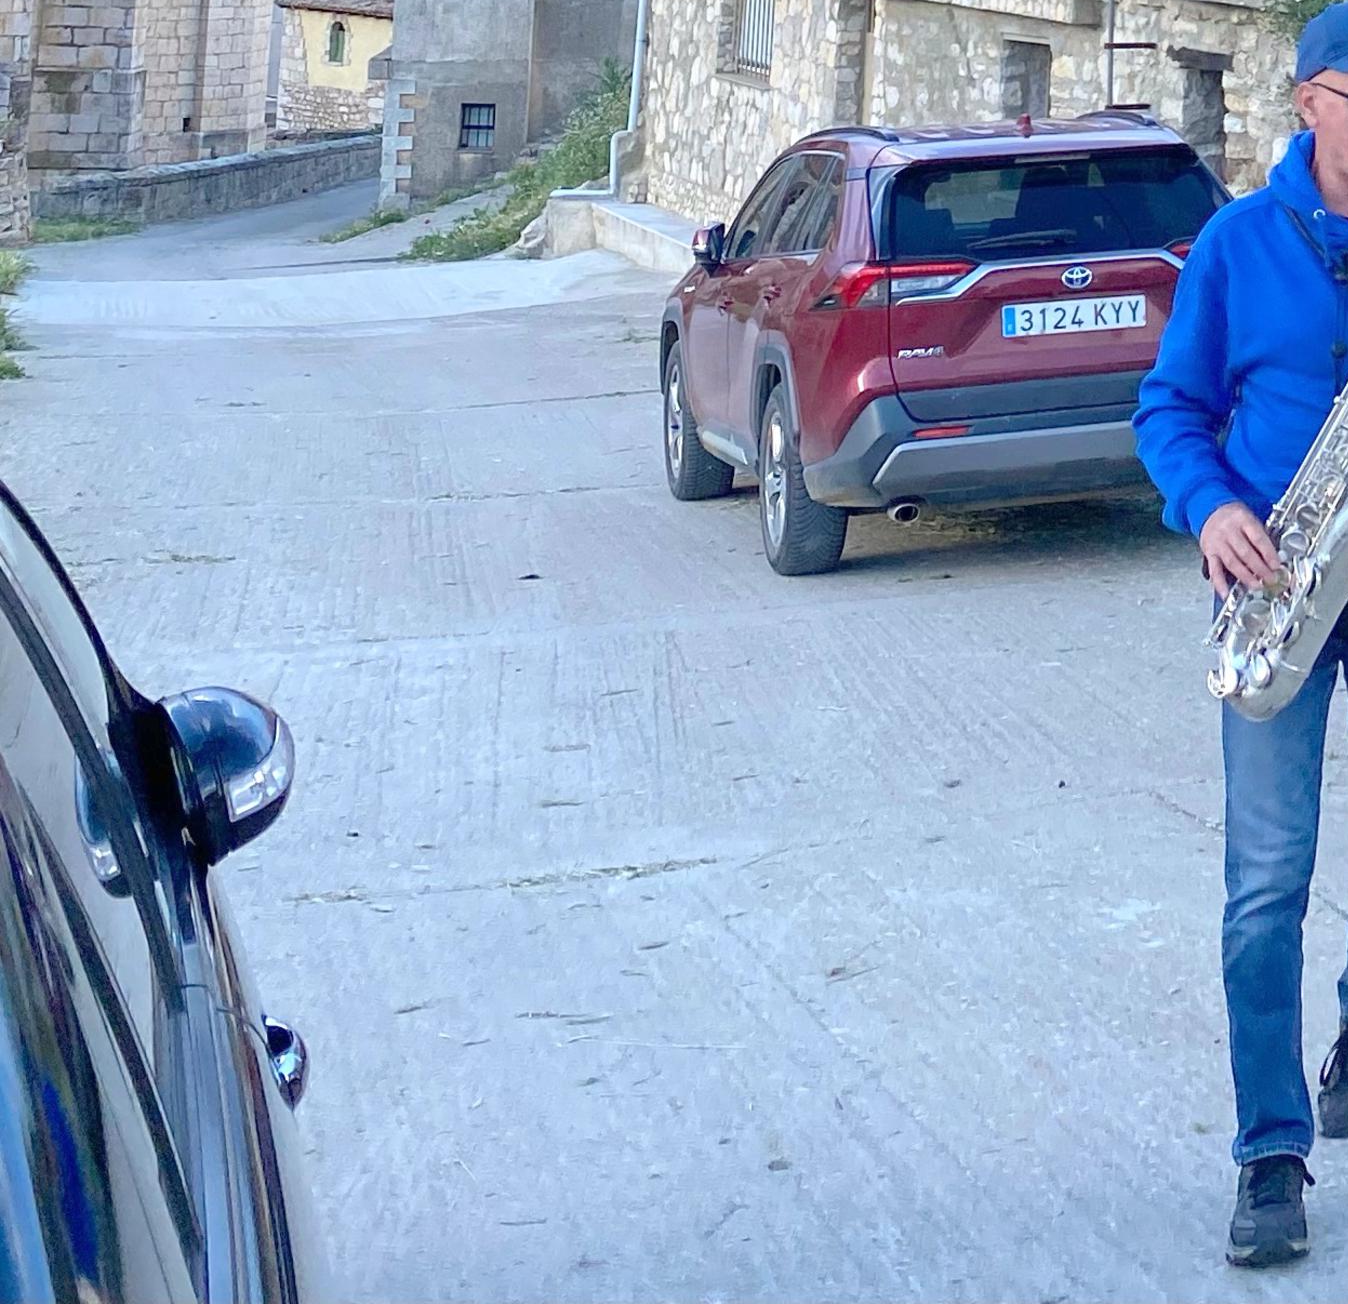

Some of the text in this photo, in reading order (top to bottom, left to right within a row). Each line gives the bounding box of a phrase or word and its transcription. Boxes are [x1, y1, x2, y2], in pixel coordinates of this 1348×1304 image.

[1020, 299, 1140, 332] 3124 KYY
[897, 345, 945, 359] RAV4
